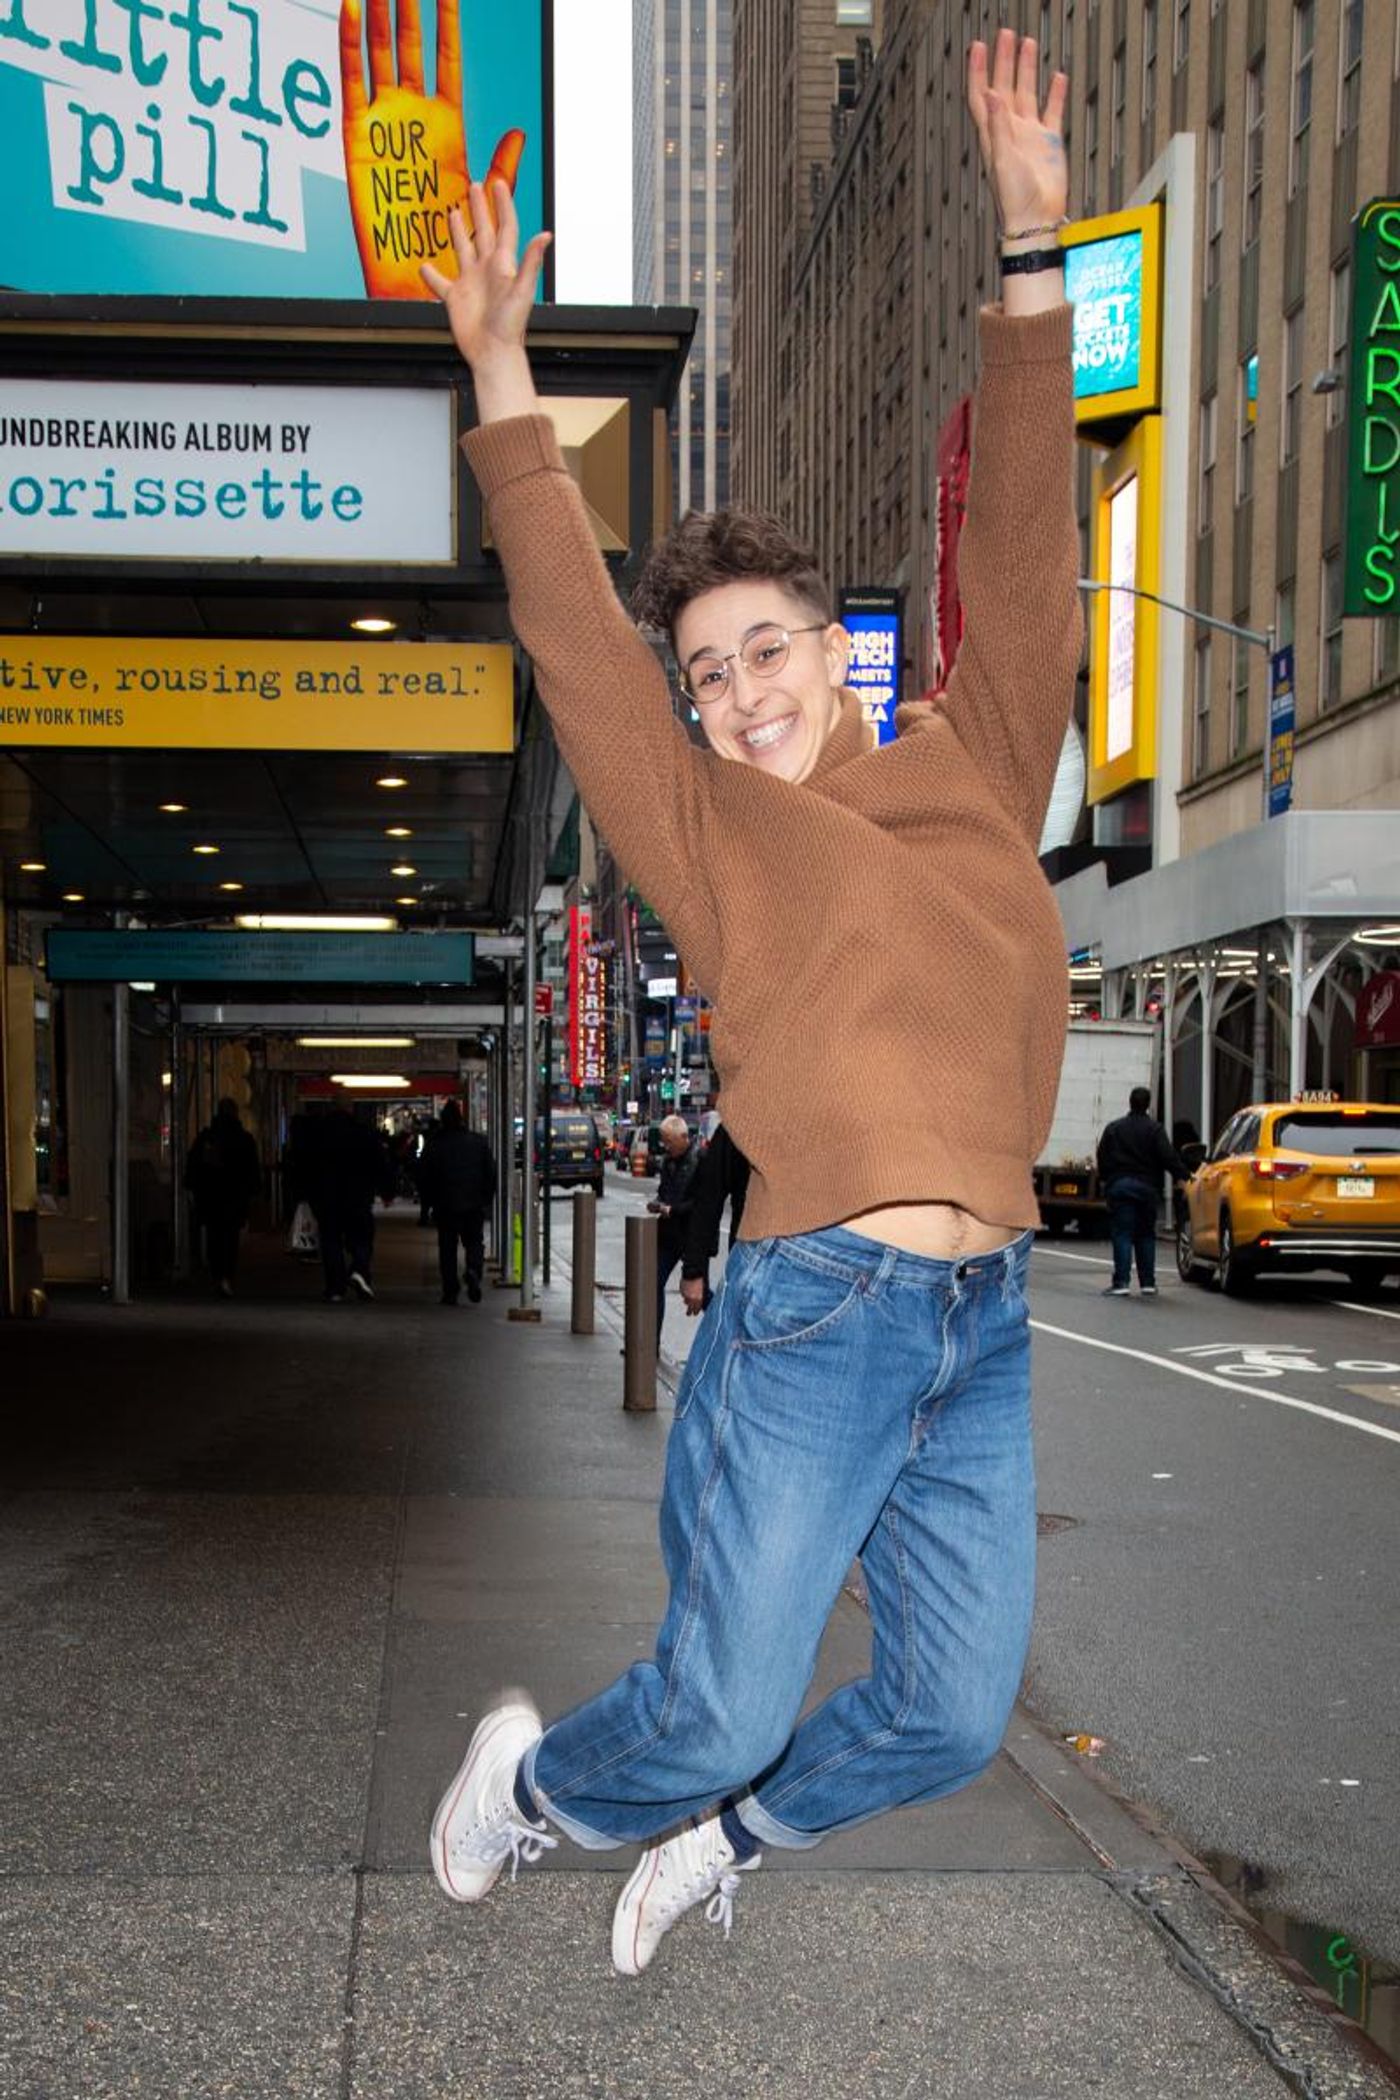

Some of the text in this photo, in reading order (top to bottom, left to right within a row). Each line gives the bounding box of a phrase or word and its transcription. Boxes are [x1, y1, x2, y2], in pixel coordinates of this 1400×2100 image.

[369, 120, 428, 166] OUR
[67, 102, 288, 233] pill
[371, 159, 439, 215] NEW
[1073, 293, 1131, 333] GET
[1072, 338, 1129, 372] NOW
[184, 422, 272, 453] ALBUM
[281, 424, 311, 453] BY
[0, 467, 363, 521] orissette
[847, 631, 894, 650] HIGH
[847, 649, 894, 666] TECH
[116, 664, 281, 700] rousing
[296, 664, 365, 695] and
[849, 668, 892, 682] MEETS
[852, 686, 894, 704] EEP
[34, 707, 74, 726] YORK
[79, 709, 125, 727] TIMES
